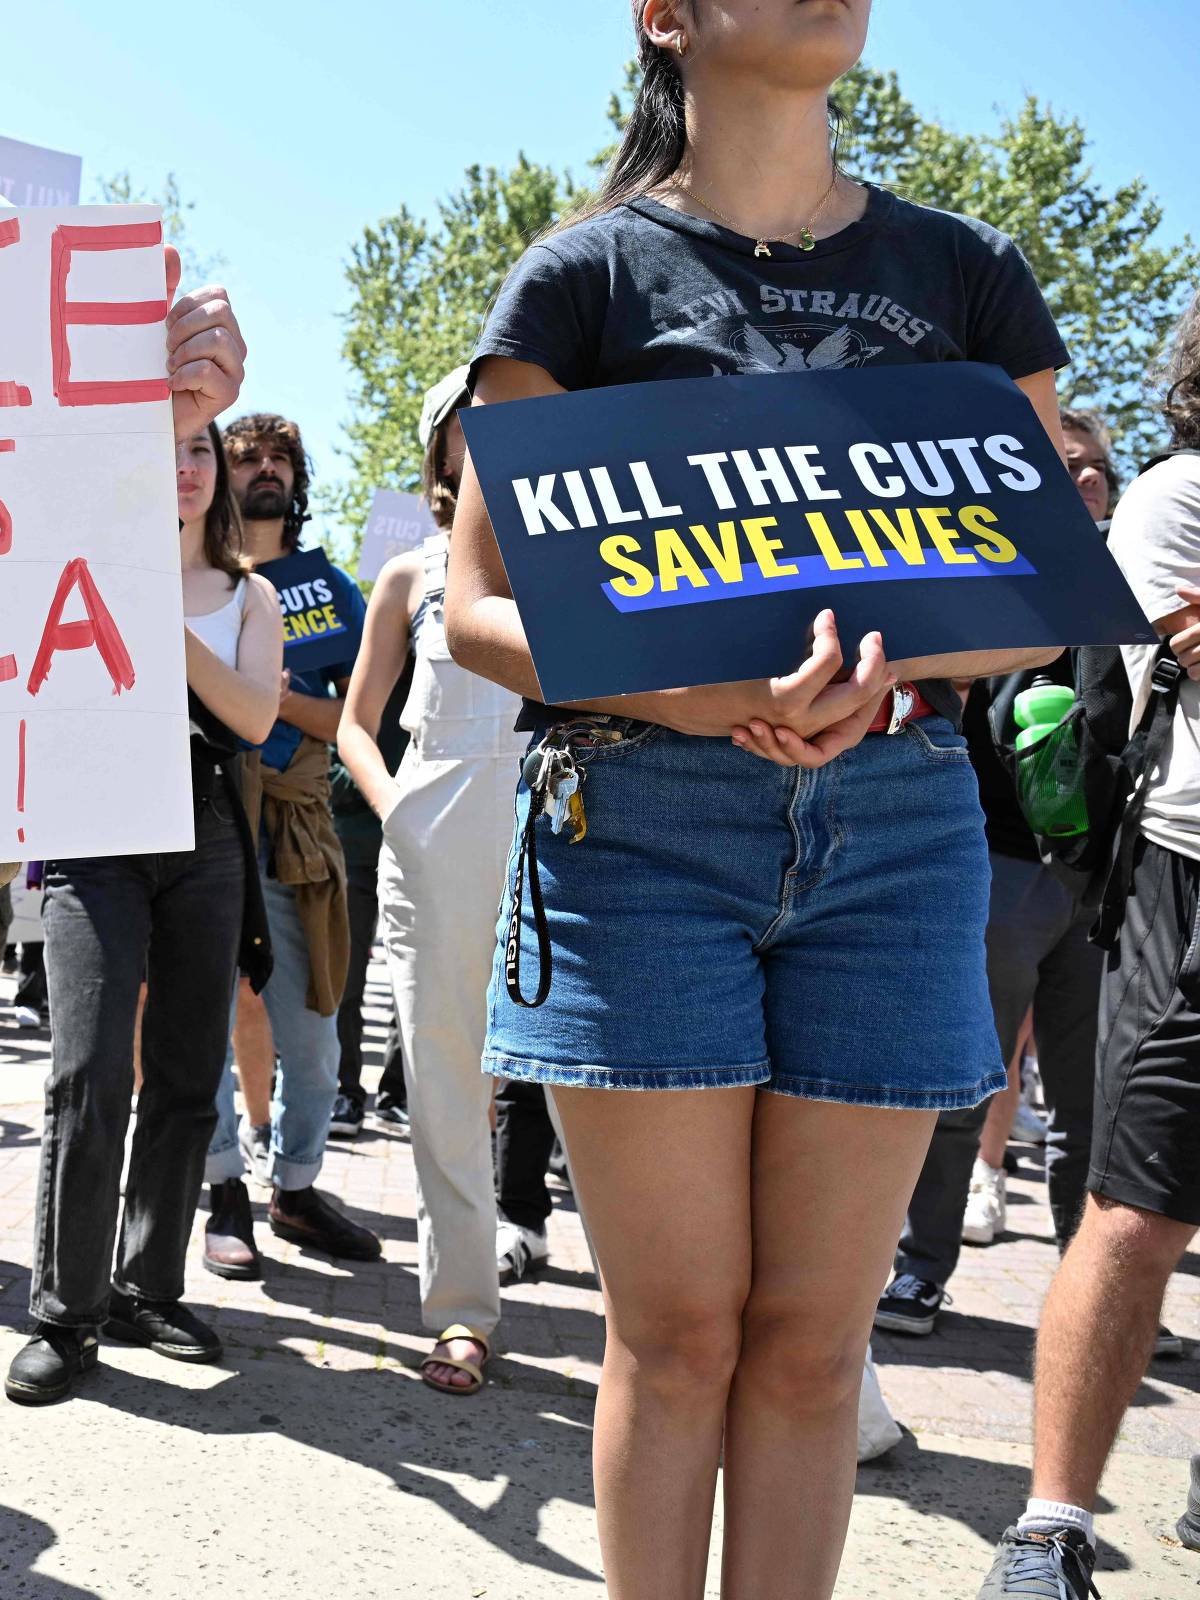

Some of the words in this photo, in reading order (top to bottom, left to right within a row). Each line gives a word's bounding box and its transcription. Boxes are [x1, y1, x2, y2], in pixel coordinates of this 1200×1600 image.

[655, 289, 749, 340] LEVI
[759, 284, 934, 346] STRAUSS
[511, 461, 683, 536] KILL
[686, 445, 842, 510] THE
[848, 434, 1042, 498] CUTS
[599, 516, 800, 597] SAVE
[804, 505, 1018, 571] LIVES
